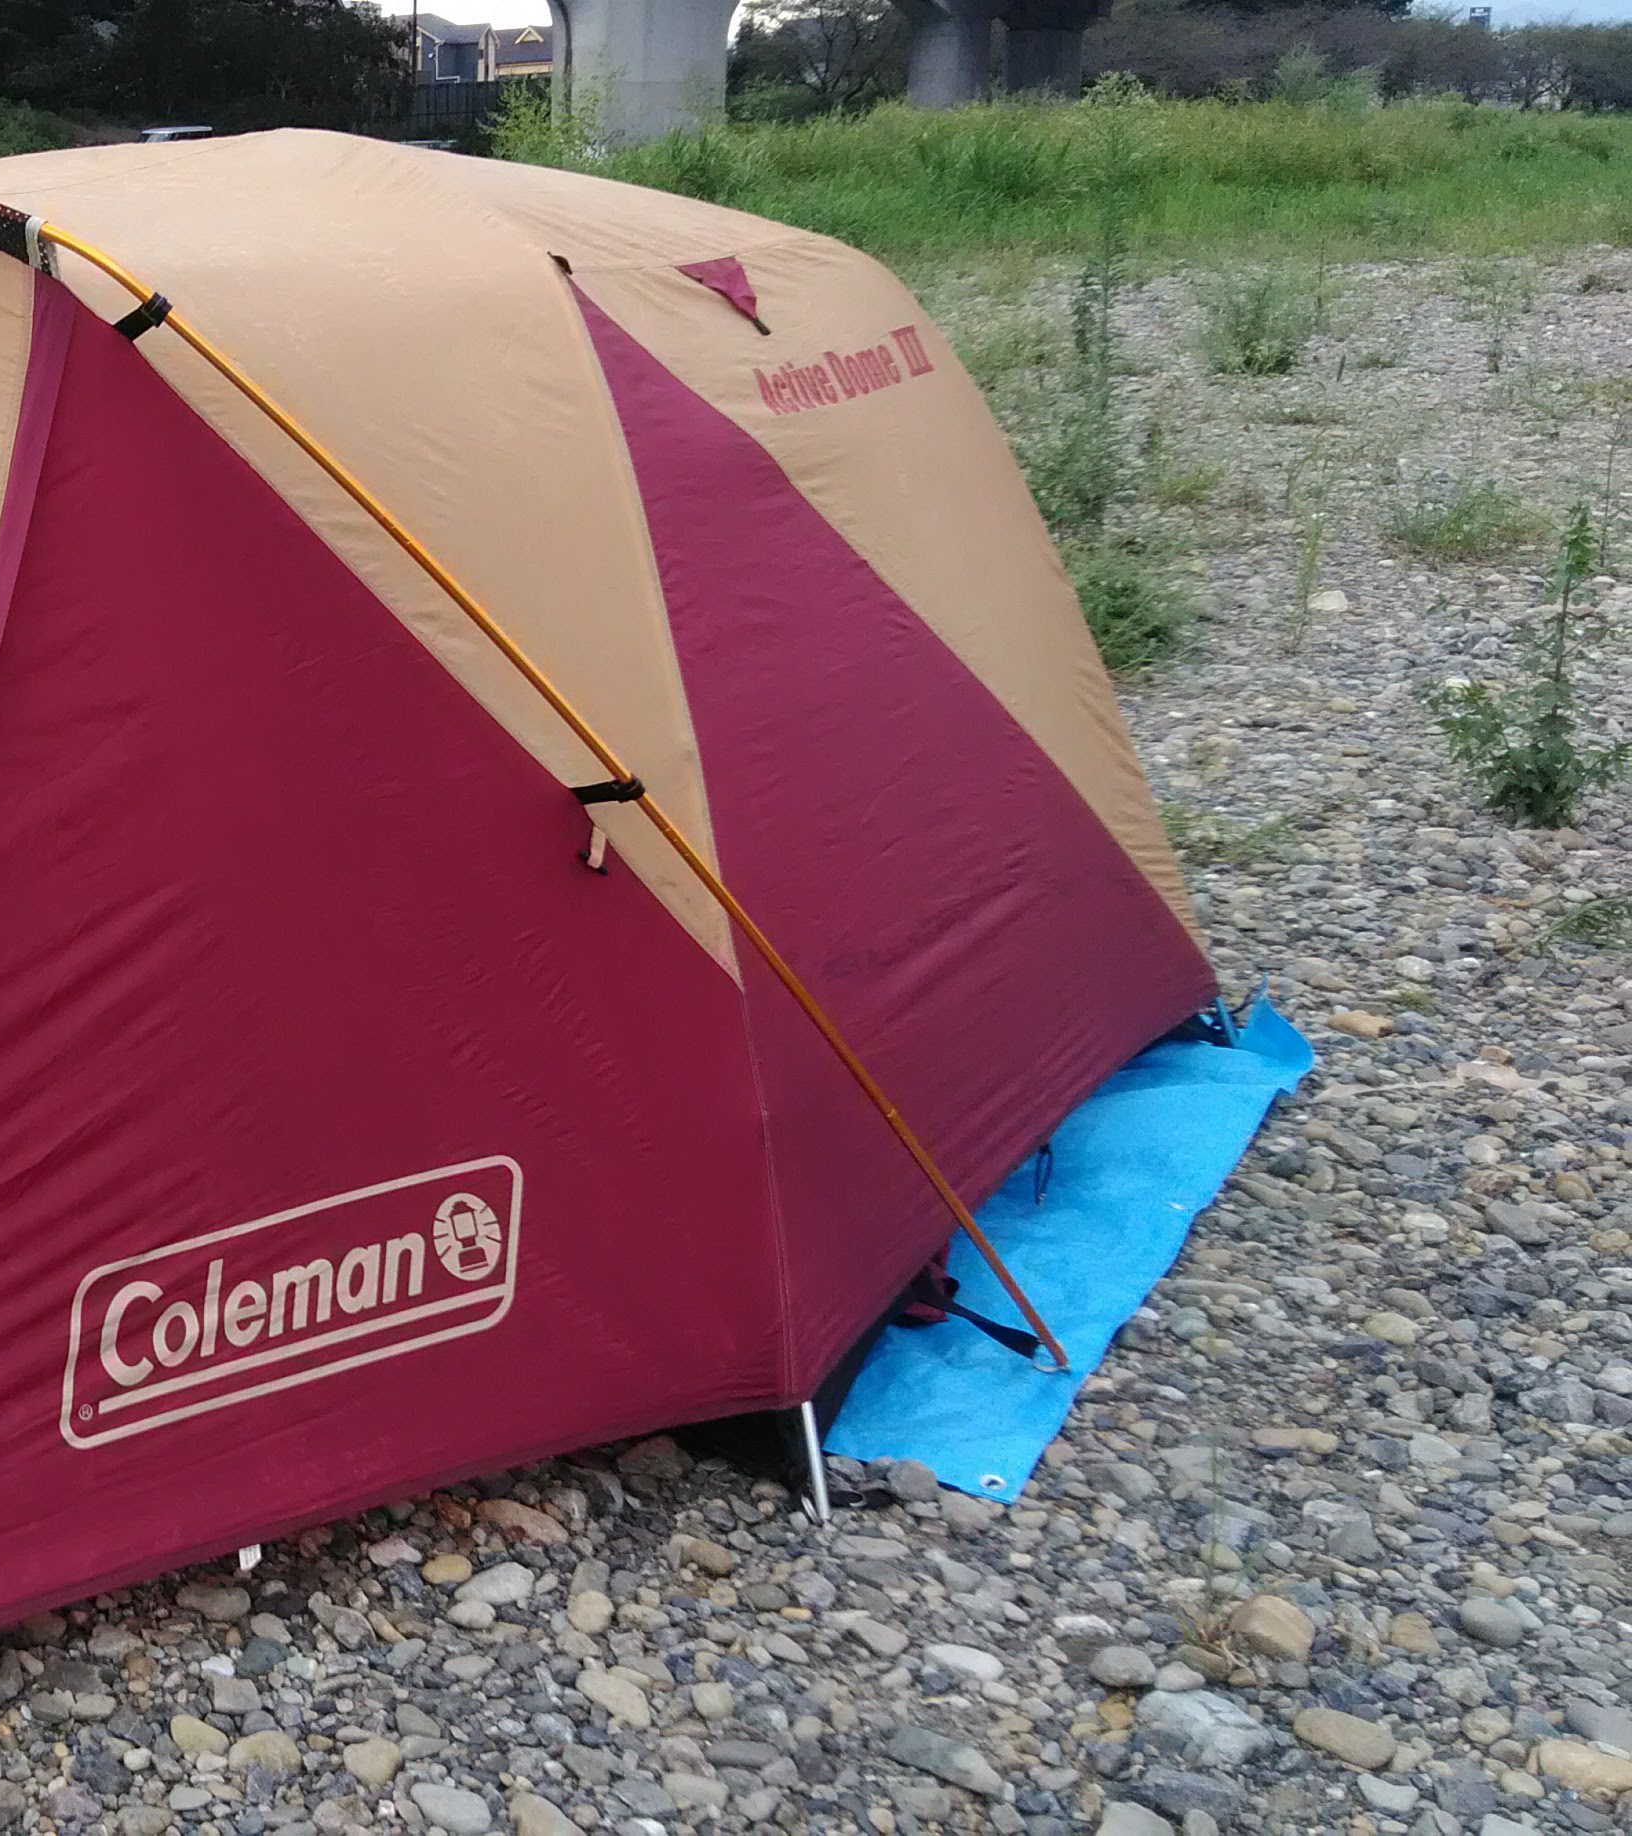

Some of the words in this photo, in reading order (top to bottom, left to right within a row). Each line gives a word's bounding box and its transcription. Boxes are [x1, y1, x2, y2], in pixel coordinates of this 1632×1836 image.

[752, 361, 839, 416] Active
[823, 344, 901, 400] Dome
[889, 324, 935, 378] III
[99, 1231, 426, 1387] Coleman
